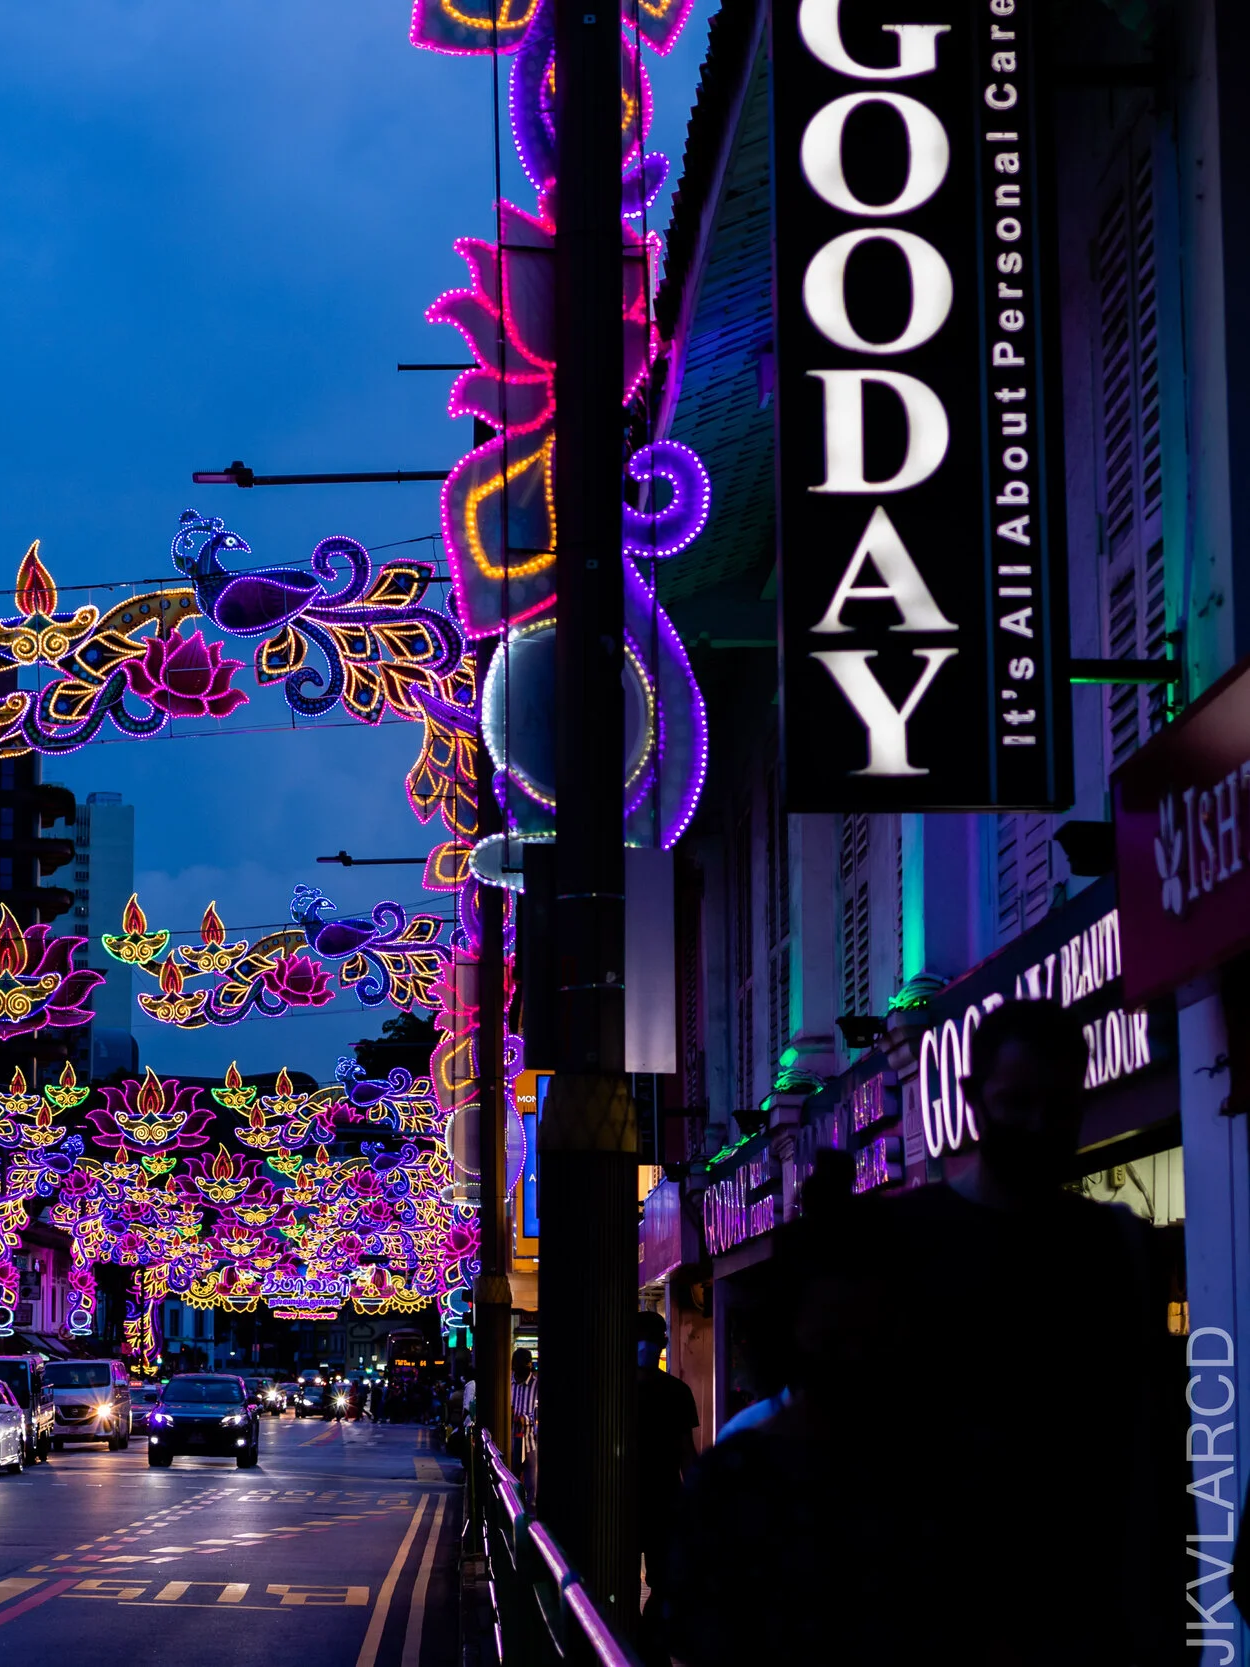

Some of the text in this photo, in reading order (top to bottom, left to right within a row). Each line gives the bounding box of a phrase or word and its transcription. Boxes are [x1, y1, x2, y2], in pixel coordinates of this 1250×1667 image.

[984, 0, 1036, 746] It's All About Personal Care
[273, 1310, 298, 1320] Happy
[58, 1578, 370, 1606] BUS
